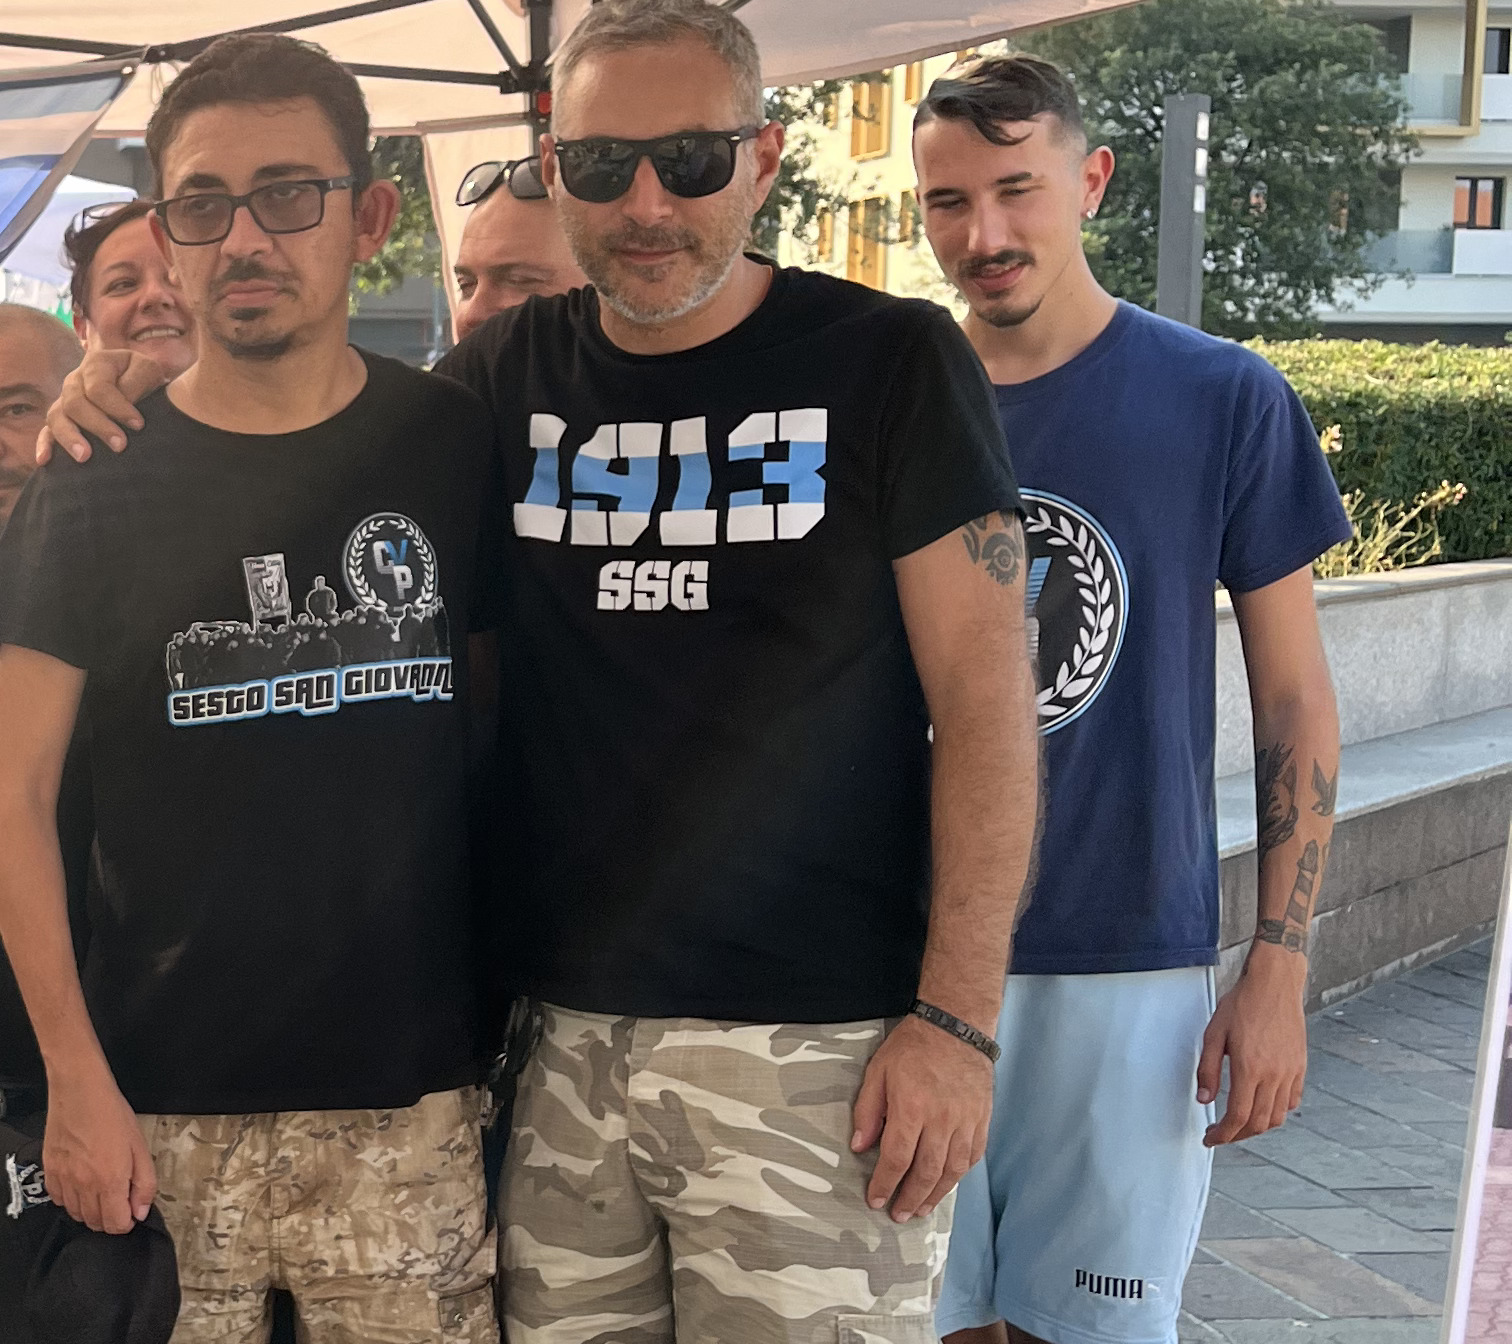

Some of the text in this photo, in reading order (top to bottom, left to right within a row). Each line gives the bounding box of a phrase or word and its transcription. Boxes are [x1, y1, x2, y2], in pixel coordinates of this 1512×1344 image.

[514, 408, 829, 547] 1913
[597, 560, 710, 610] SSG
[172, 662, 453, 721] SESTO SAN GIOVANN
[1075, 1268, 1144, 1299] PUMA
